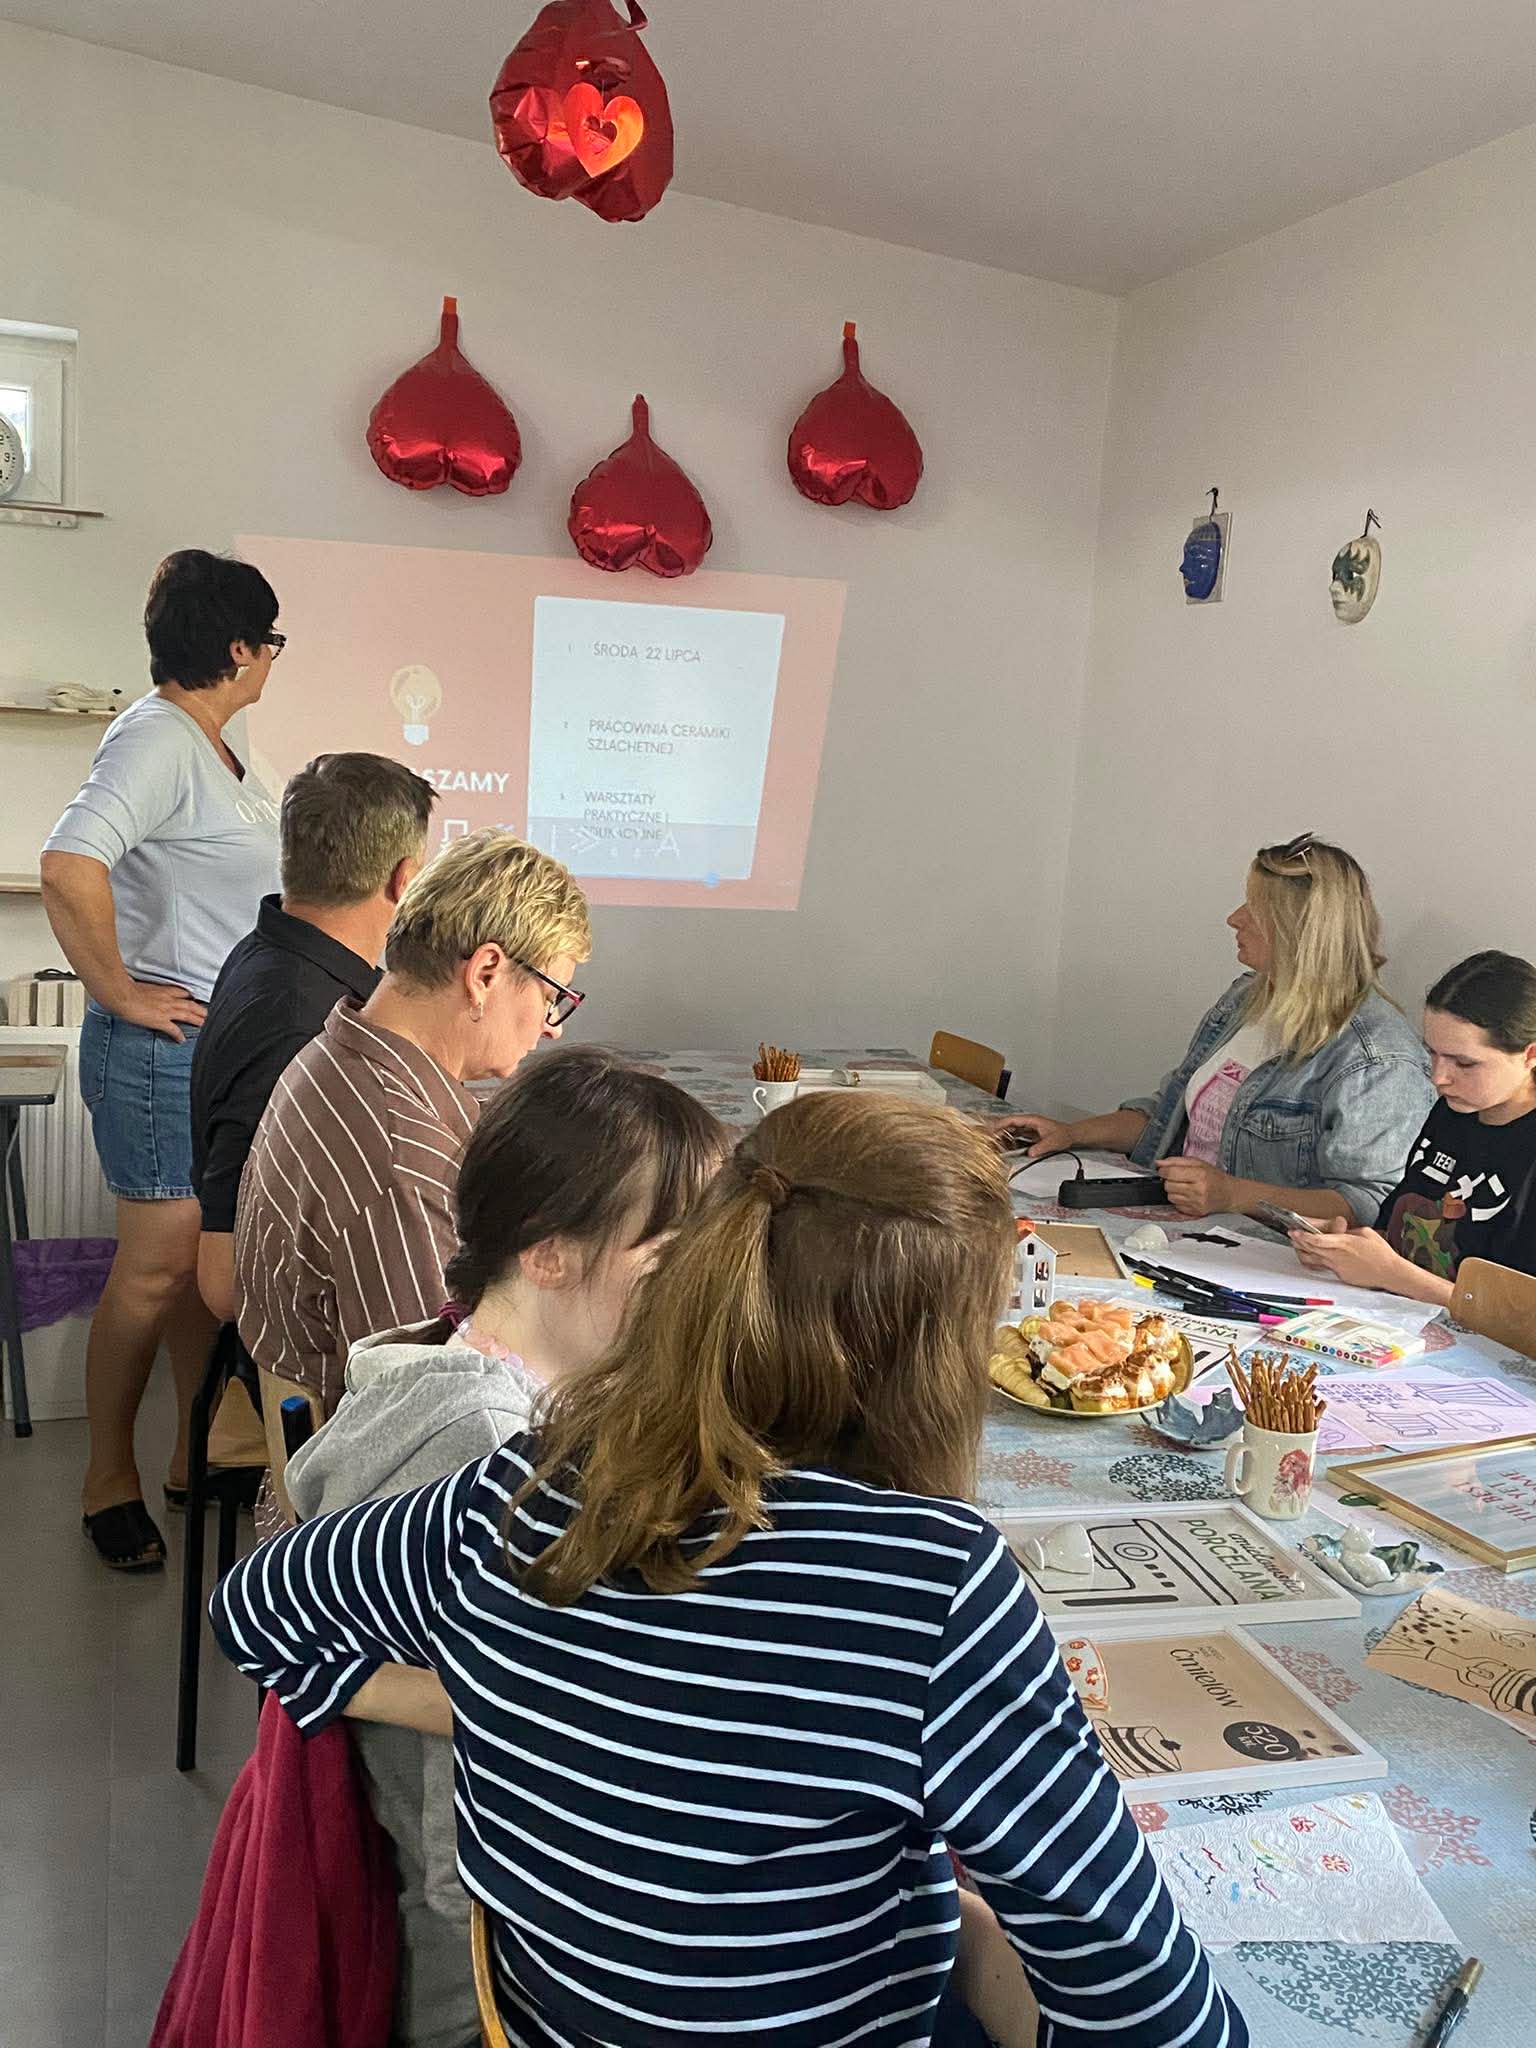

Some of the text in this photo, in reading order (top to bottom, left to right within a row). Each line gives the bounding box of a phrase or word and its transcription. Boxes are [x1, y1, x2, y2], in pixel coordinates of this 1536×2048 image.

[593, 642, 638, 659] ŚRODA
[645, 646, 661, 661] 22
[665, 648, 701, 663] LIPCA
[589, 719, 668, 735] PRACOWNIA
[671, 724, 731, 738] CERAMIKI
[587, 738, 674, 754] SZLACHETNEJ
[420, 768, 510, 794] SZAMY
[584, 791, 656, 806] WARSZTATY
[583, 809, 663, 824] PRAKTYCZNE
[1178, 1519, 1286, 1600] PORCELANA
[1244, 1725, 1290, 1755] 520
